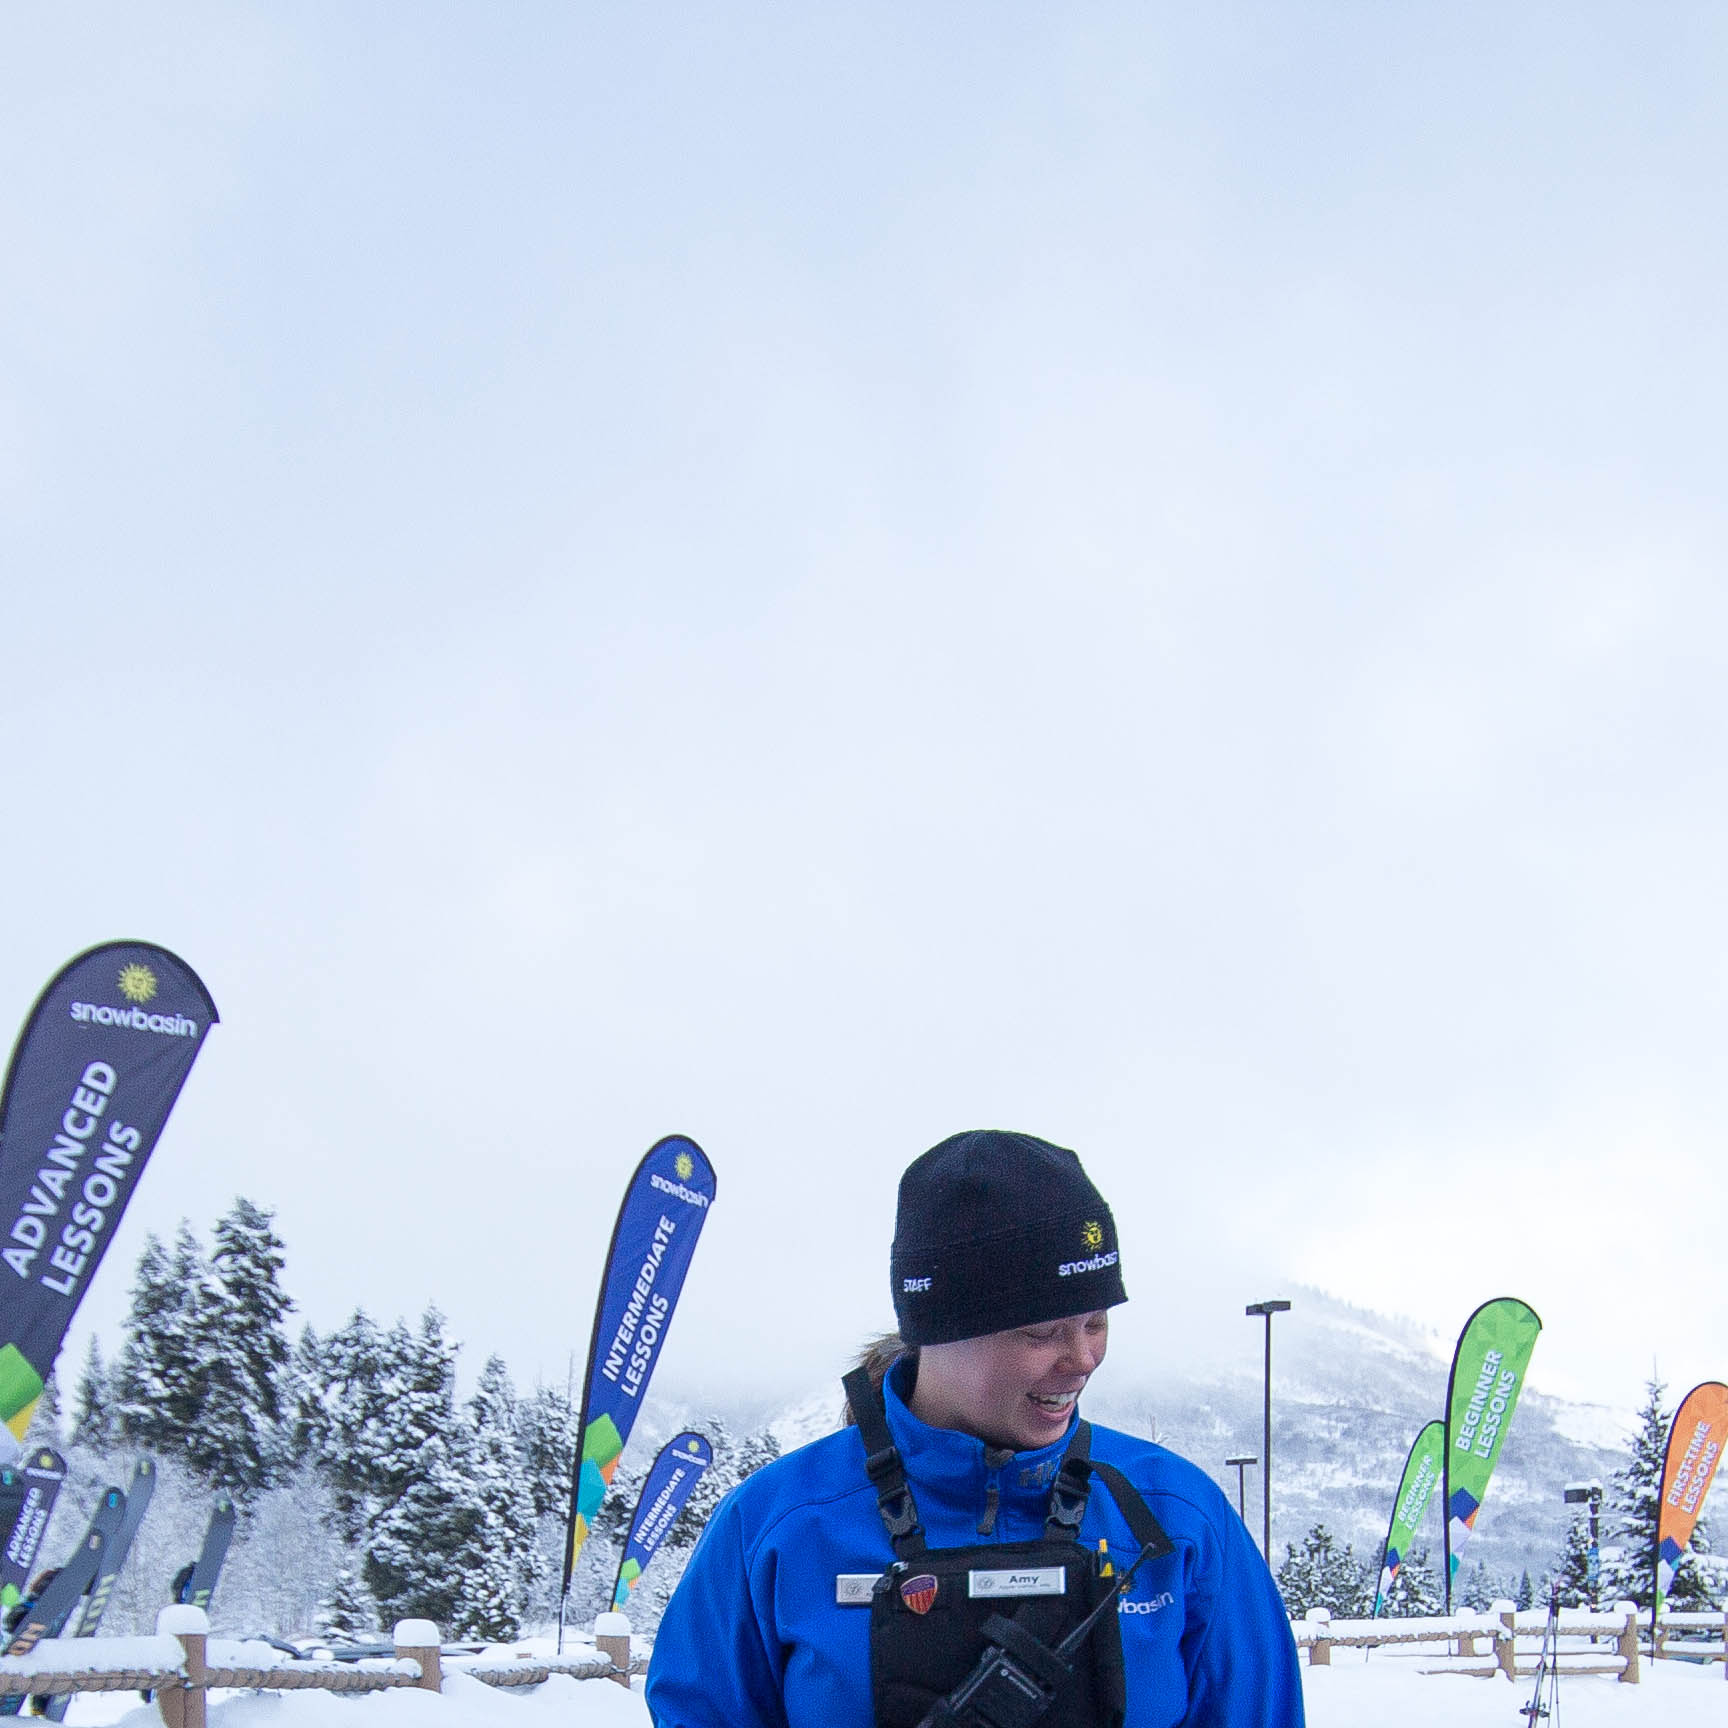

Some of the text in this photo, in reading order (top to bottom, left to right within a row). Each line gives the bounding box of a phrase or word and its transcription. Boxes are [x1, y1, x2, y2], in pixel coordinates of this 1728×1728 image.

[70, 1000, 199, 1038] snowbasin
[0, 1060, 119, 1279] ADVANCED
[650, 1173, 709, 1209] snowbasin
[41, 1120, 143, 1297] LESSONS
[603, 1216, 675, 1382] INTERMEDIATE
[903, 1277, 933, 1293] STAFF
[1058, 1251, 1119, 1277] snowbas
[621, 1293, 669, 1398] LESSONS
[1454, 1348, 1504, 1453] BEGINNER
[1475, 1368, 1517, 1460] LESSONS
[1398, 1453, 1434, 1523] BEGINNER
[1666, 1420, 1712, 1508] FIRST-TIME
[1681, 1440, 1719, 1515] LESSONS
[6, 1487, 42, 1563] ADVANCED
[634, 1467, 686, 1545] INTERMEDIATE
[643, 1504, 678, 1552] LESSONS
[1405, 1471, 1437, 1531] LESSONS
[17, 1508, 46, 1568] LESSONS
[1009, 1575, 1040, 1586] Amy
[1117, 1591, 1174, 1615] basin
